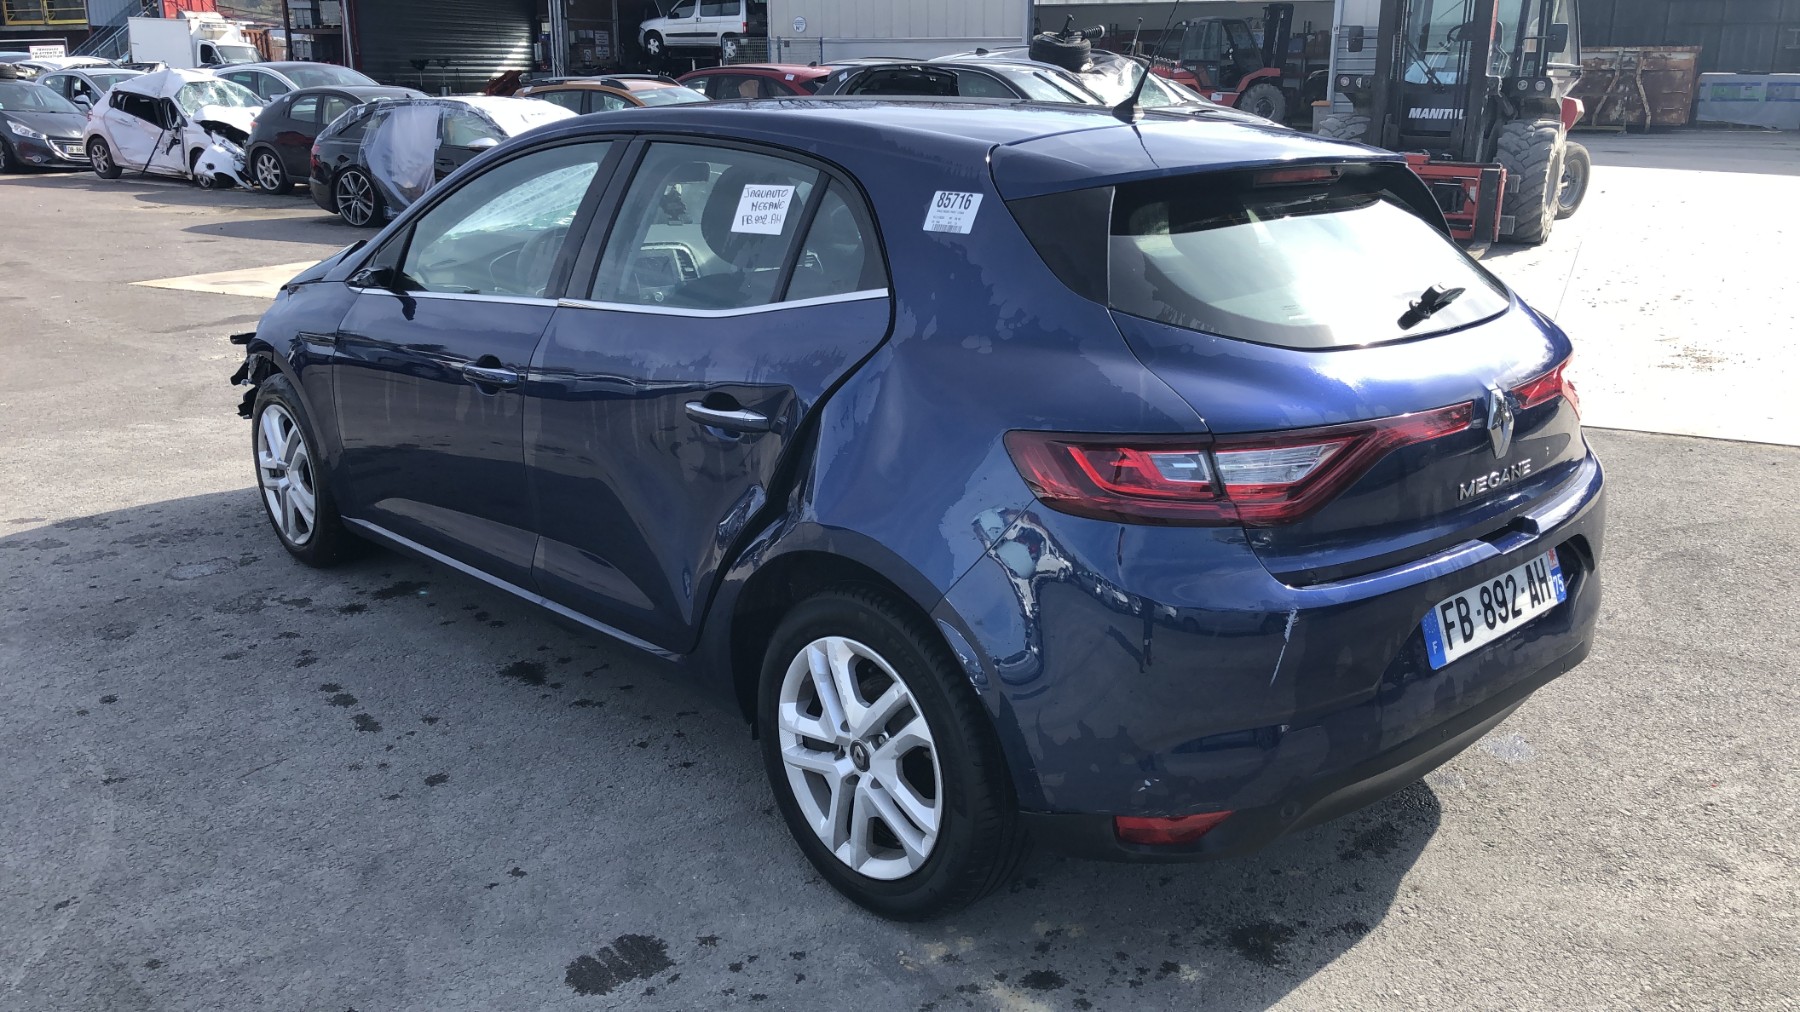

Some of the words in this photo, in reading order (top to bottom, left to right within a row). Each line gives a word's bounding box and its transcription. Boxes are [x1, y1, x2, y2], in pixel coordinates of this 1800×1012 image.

[743, 187, 788, 198] JAQUAUTO
[937, 192, 973, 210] 85716
[1459, 458, 1531, 501] MEGANE
[1553, 573, 1564, 596] 75
[1431, 640, 1438, 654] F
